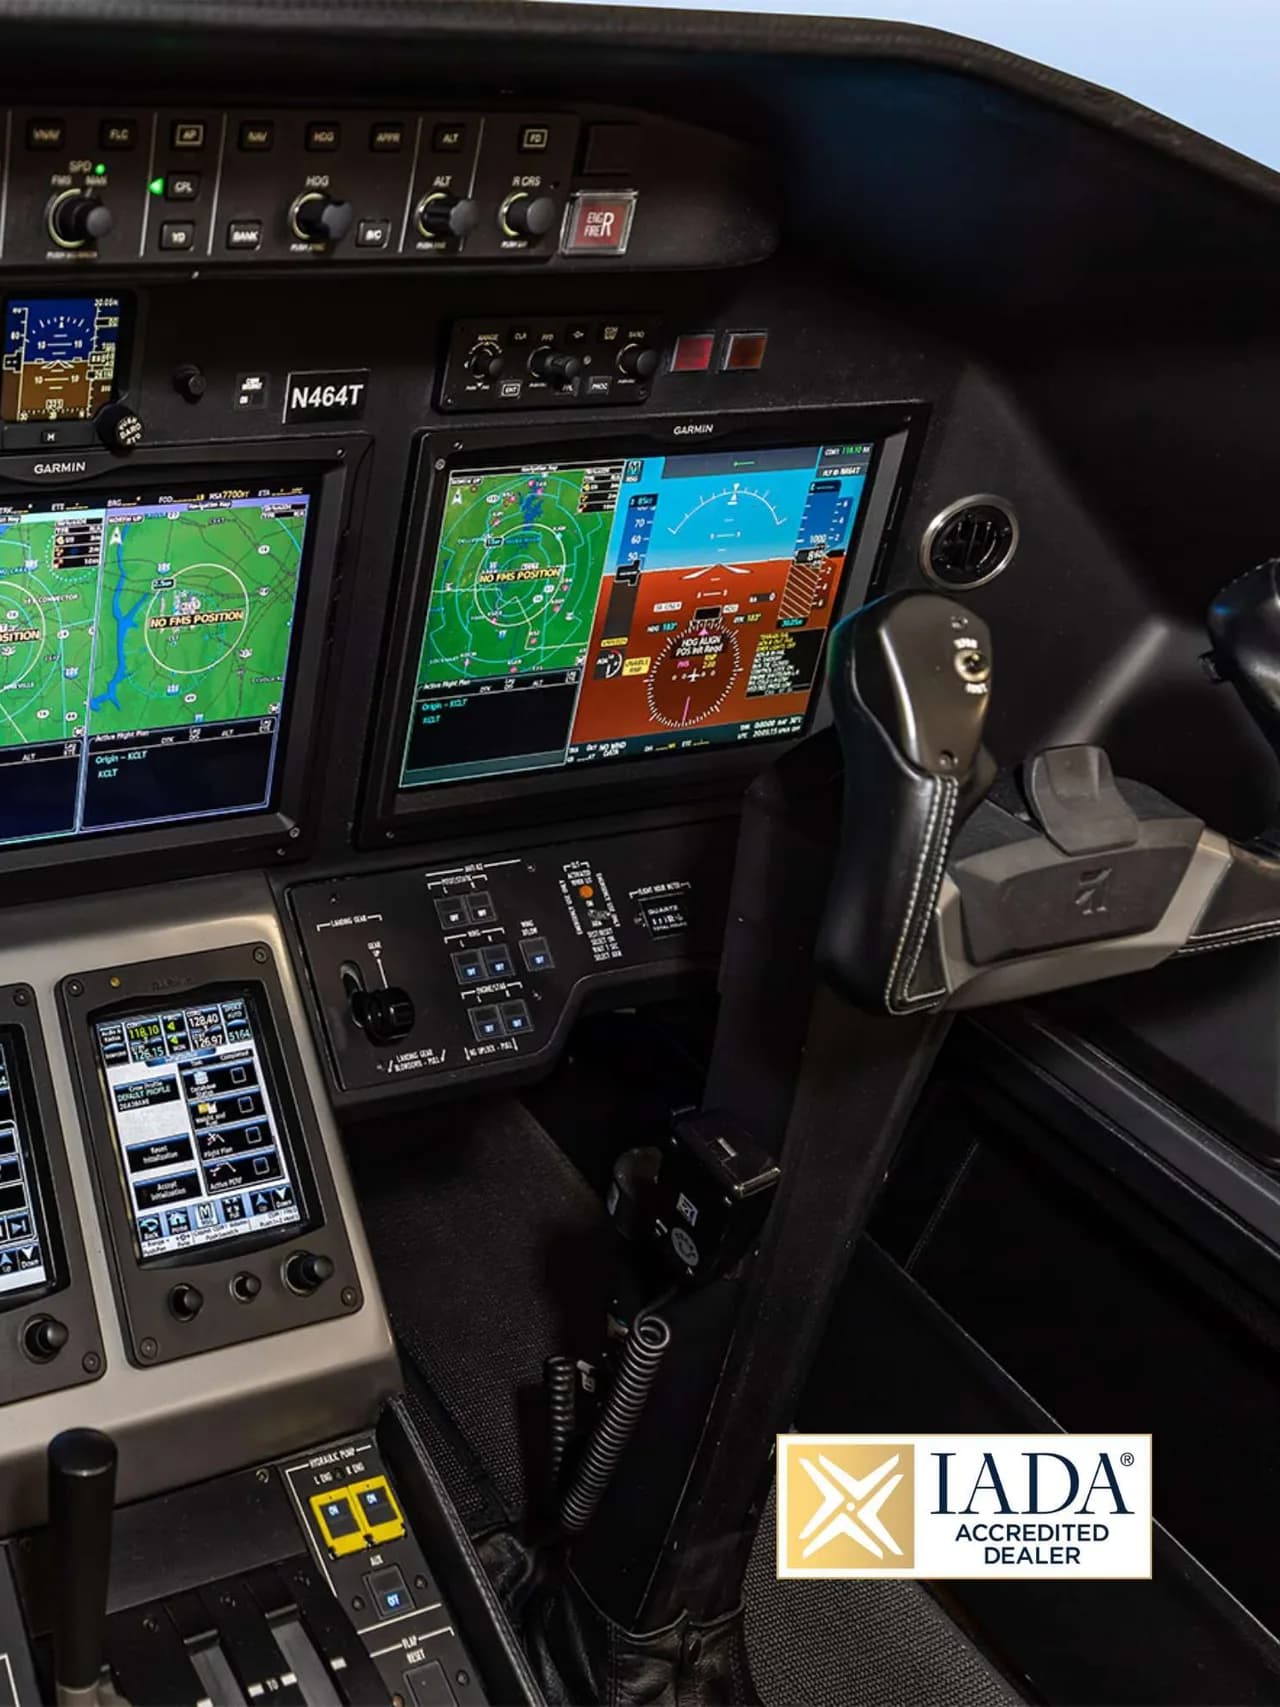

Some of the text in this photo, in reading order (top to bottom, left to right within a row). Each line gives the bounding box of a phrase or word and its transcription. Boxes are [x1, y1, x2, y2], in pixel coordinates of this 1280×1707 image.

[110, 129, 129, 140] FLC
[314, 132, 335, 143] HDG
[376, 132, 401, 143] APPR
[442, 133, 459, 143] ALT
[70, 161, 93, 172] SPD
[306, 176, 330, 187] HDG
[433, 176, 452, 187] ALT
[512, 175, 541, 187] R CRS
[175, 182, 192, 193] CPL
[587, 212, 615, 237] ENG R
[232, 231, 258, 242] BANK
[584, 225, 601, 238] FIRE
[477, 333, 499, 342] RANGE
[291, 384, 364, 409] N464T
[673, 424, 713, 436] GARMIN
[34, 462, 86, 474] GARMIN
[634, 518, 645, 527] 70
[631, 535, 642, 545] 60
[809, 534, 827, 544] 1000
[627, 552, 639, 561] 50
[479, 568, 560, 584] NO FMS POSITION
[150, 610, 244, 629] NO FMS POSITION
[682, 635, 721, 647] HDG ALIGN
[95, 750, 148, 765] Origin KCLT
[97, 768, 119, 779] KCLT
[648, 904, 678, 915] QUARTZ
[331, 914, 368, 927] LANDING GEAR
[367, 941, 382, 949] GEAR
[128, 1013, 219, 1040] 118.10 128.40
[133, 1046, 165, 1061] 126.15
[193, 1034, 224, 1049] 126.97
[228, 1028, 252, 1041] 5164
[396, 1048, 433, 1062] LANDING GEAR
[117, 1085, 171, 1102] DEFAULT PROFILE
[308, 1447, 356, 1468] HYDRAULIC PUMP
[328, 1493, 378, 1517] ON ON
[370, 1554, 384, 1567] AUX
[387, 1593, 401, 1607] OFF
[401, 1636, 418, 1649] FLAP
[406, 1649, 425, 1665] RESET
[266, 1679, 279, 1692] TO
